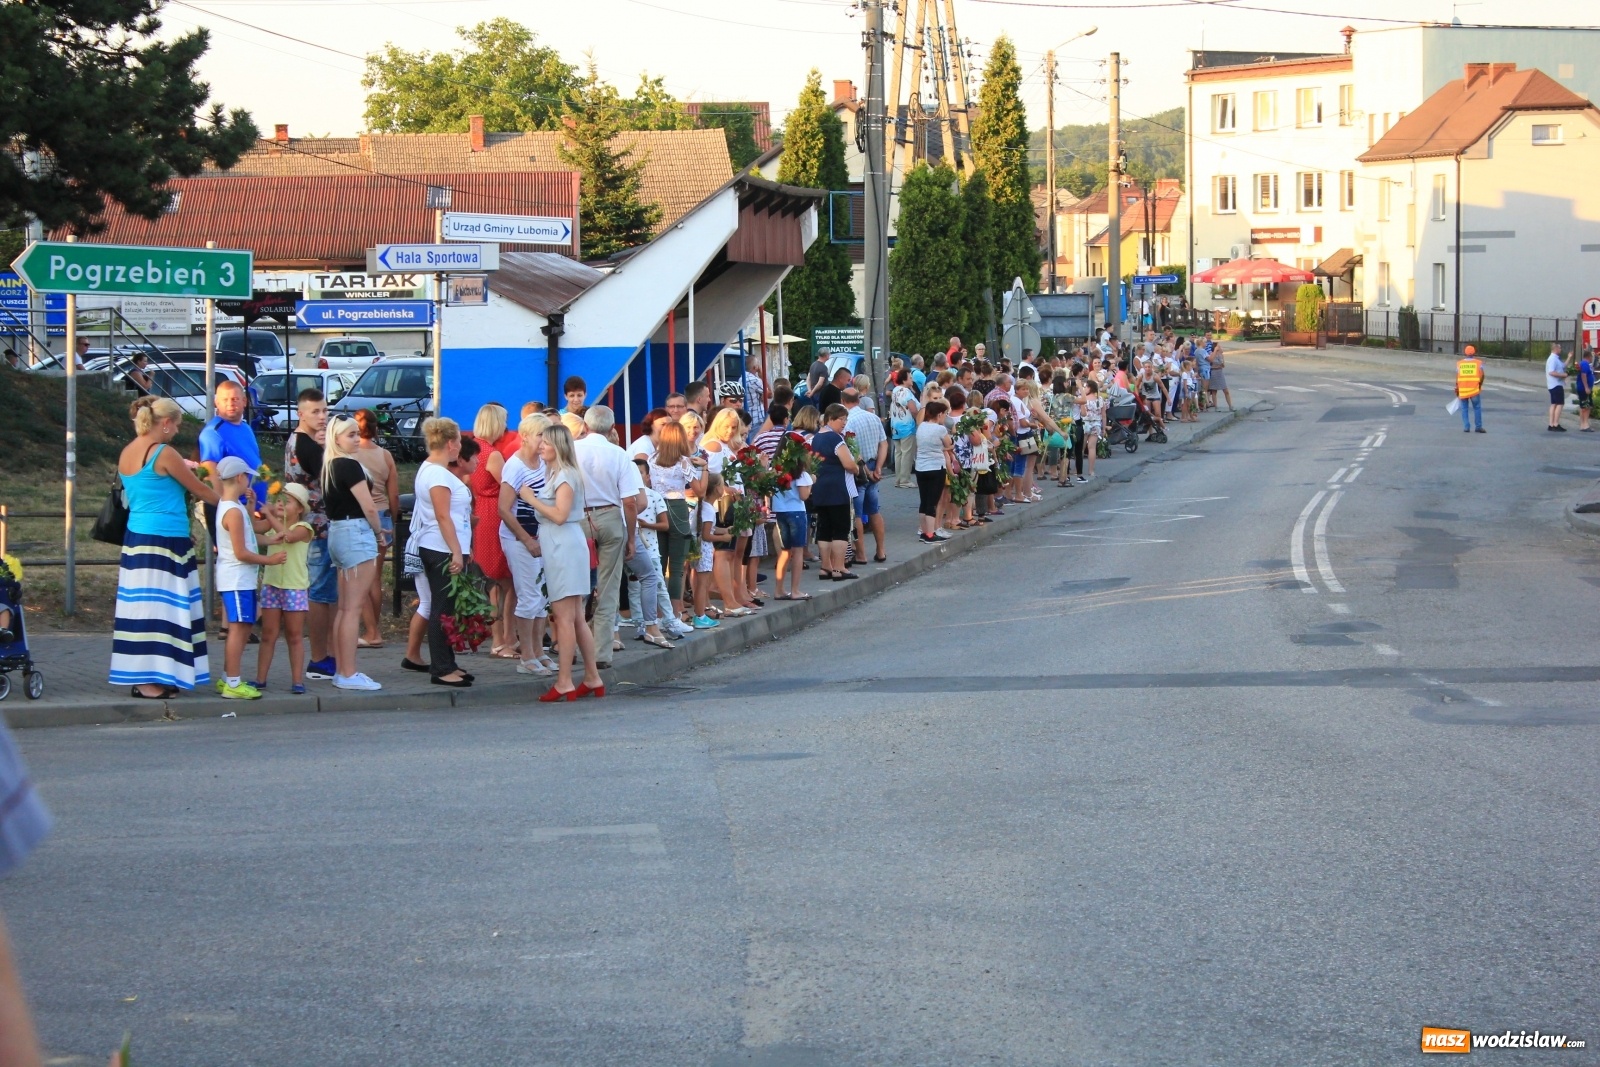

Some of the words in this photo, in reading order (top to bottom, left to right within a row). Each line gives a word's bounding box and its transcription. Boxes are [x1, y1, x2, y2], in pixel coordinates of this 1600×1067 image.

[453, 222, 481, 235] Urząd
[484, 223, 514, 236] Gminy
[517, 224, 558, 236] Lubomia
[396, 252, 421, 264] Hala
[427, 251, 478, 266] Sportowa
[50, 255, 205, 289] Pogrzebień
[219, 262, 235, 287] 3
[315, 273, 418, 288] TARTAK
[344, 290, 390, 298] WINKLER
[322, 308, 335, 319] ul.
[337, 308, 414, 322] Pogrzebieńska
